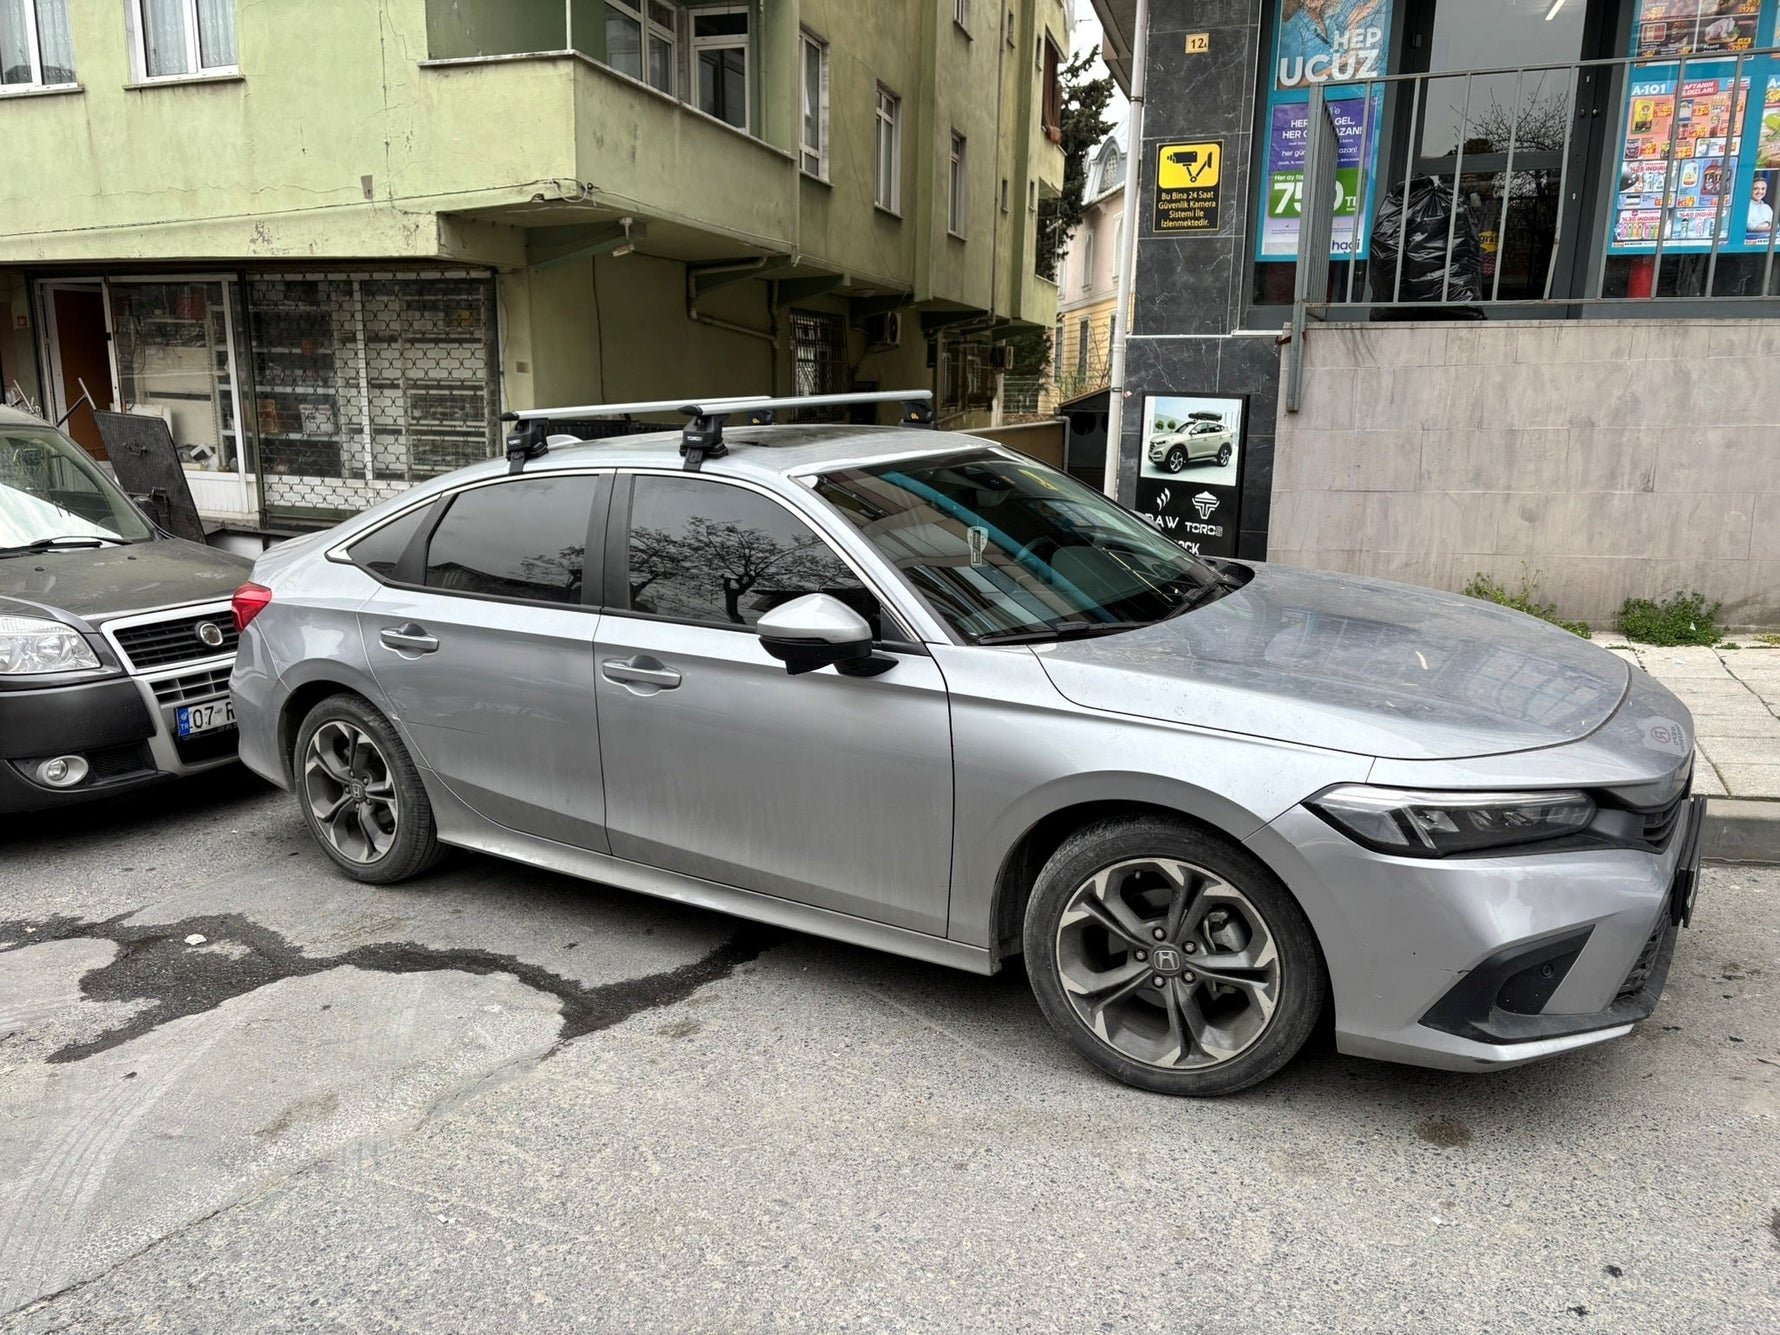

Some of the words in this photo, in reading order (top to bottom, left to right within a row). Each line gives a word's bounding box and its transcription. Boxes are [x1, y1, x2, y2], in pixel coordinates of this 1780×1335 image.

[1333, 27, 1382, 50] HEP
[1279, 48, 1380, 87] UCUZ
[1684, 82, 1714, 90] AFTANIN
[1334, 116, 1356, 126] GEL,
[1282, 130, 1301, 139] HER
[1336, 126, 1363, 136] ZAN!
[1338, 146, 1358, 154] azan!
[1161, 192, 1171, 200] Bu
[1172, 192, 1187, 200] Bina
[1188, 191, 1198, 199] 24
[1199, 190, 1214, 198] Saat
[1158, 201, 1188, 210] Güvenlik
[1189, 200, 1216, 208] Kamera
[1169, 210, 1194, 218] Sistemi
[181, 722, 189, 731] TR
[193, 705, 214, 729] 07
